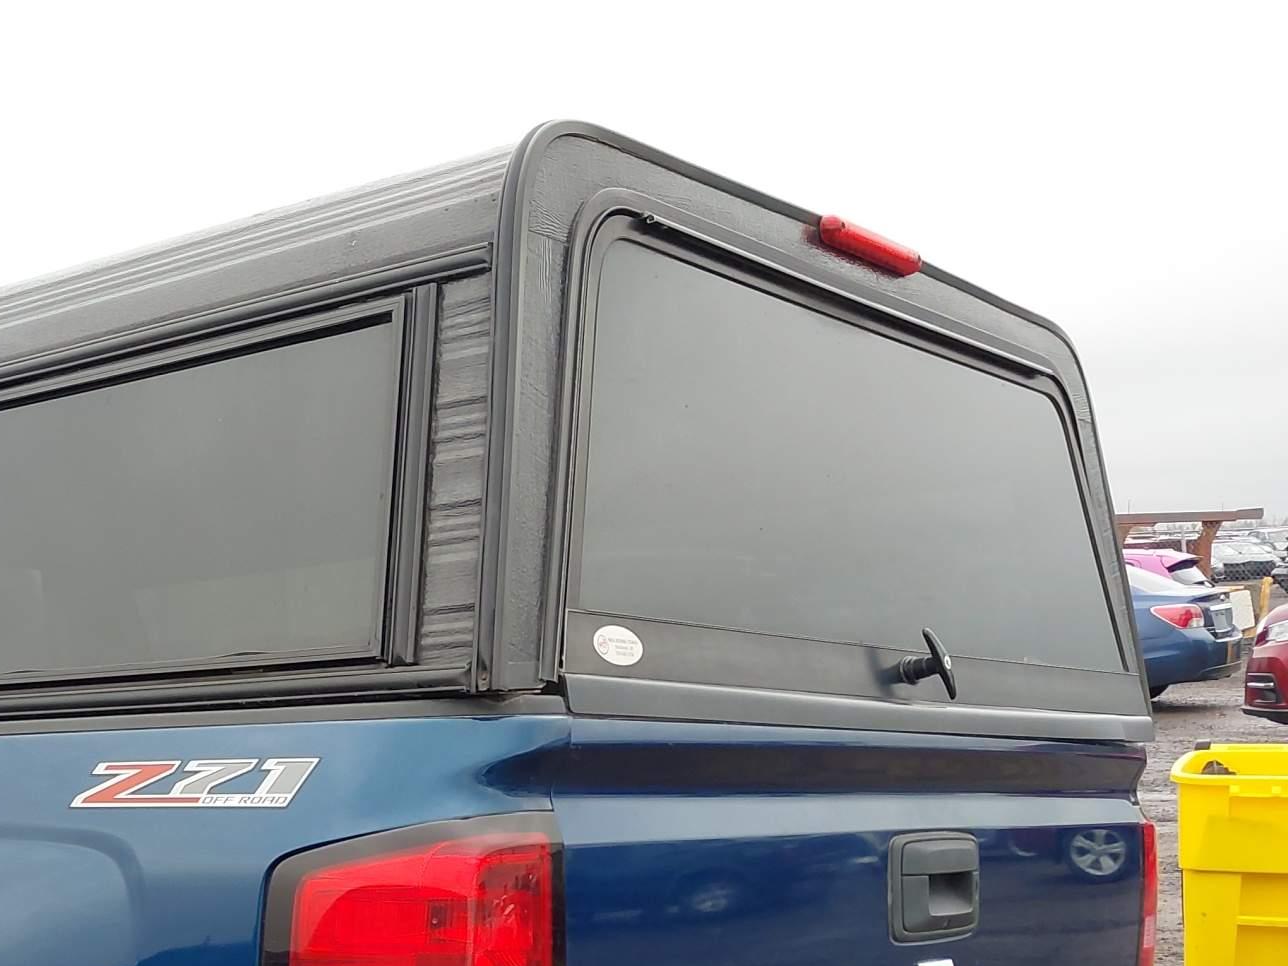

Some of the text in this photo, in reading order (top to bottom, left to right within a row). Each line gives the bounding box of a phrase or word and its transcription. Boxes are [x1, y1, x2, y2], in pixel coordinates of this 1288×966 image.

[70, 757, 320, 807] Z71
[201, 796, 289, 805] OFF ROAD
